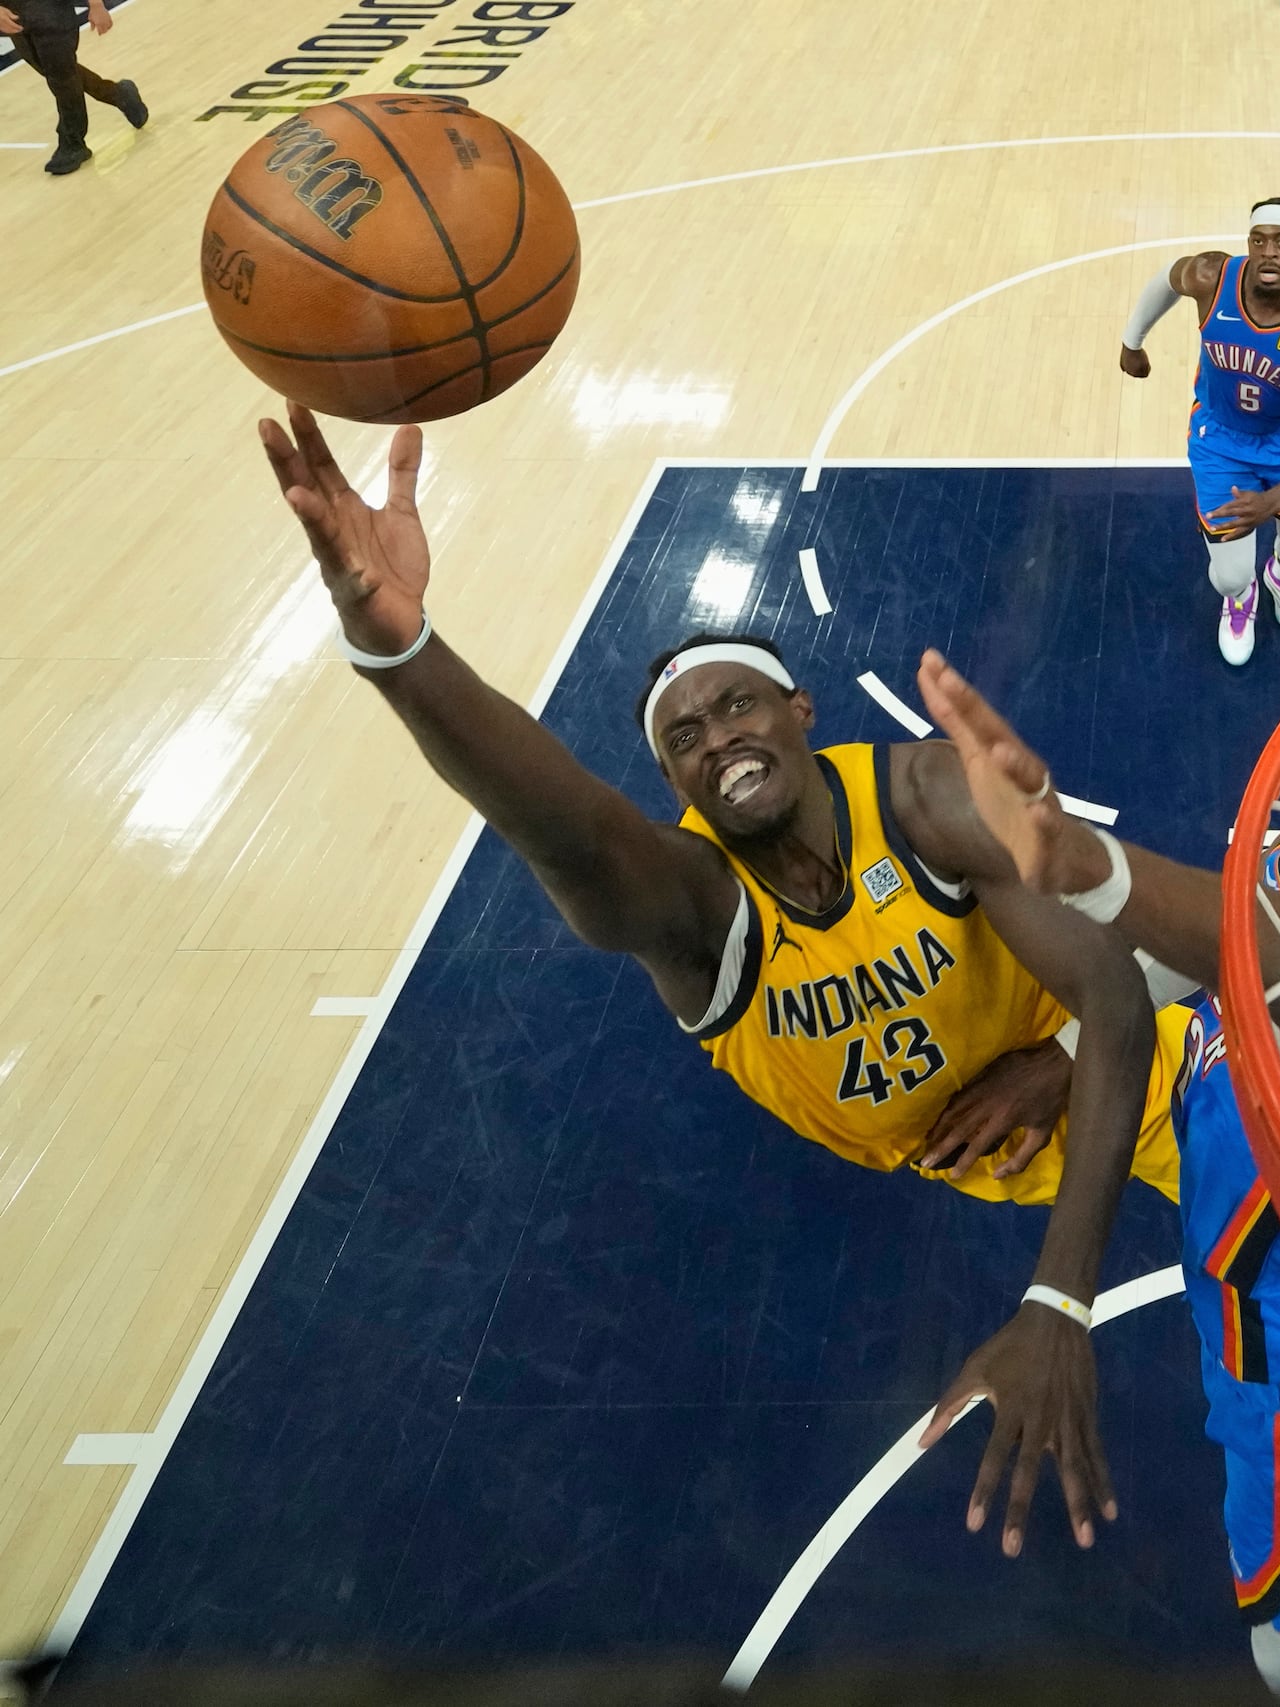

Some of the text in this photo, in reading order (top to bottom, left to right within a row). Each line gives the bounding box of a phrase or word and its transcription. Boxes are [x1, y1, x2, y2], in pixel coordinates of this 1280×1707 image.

[393, 1, 576, 107] BRID
[1238, 382, 1263, 413] 5
[765, 926, 959, 1040] INDIANA
[836, 1015, 947, 1108] 43
